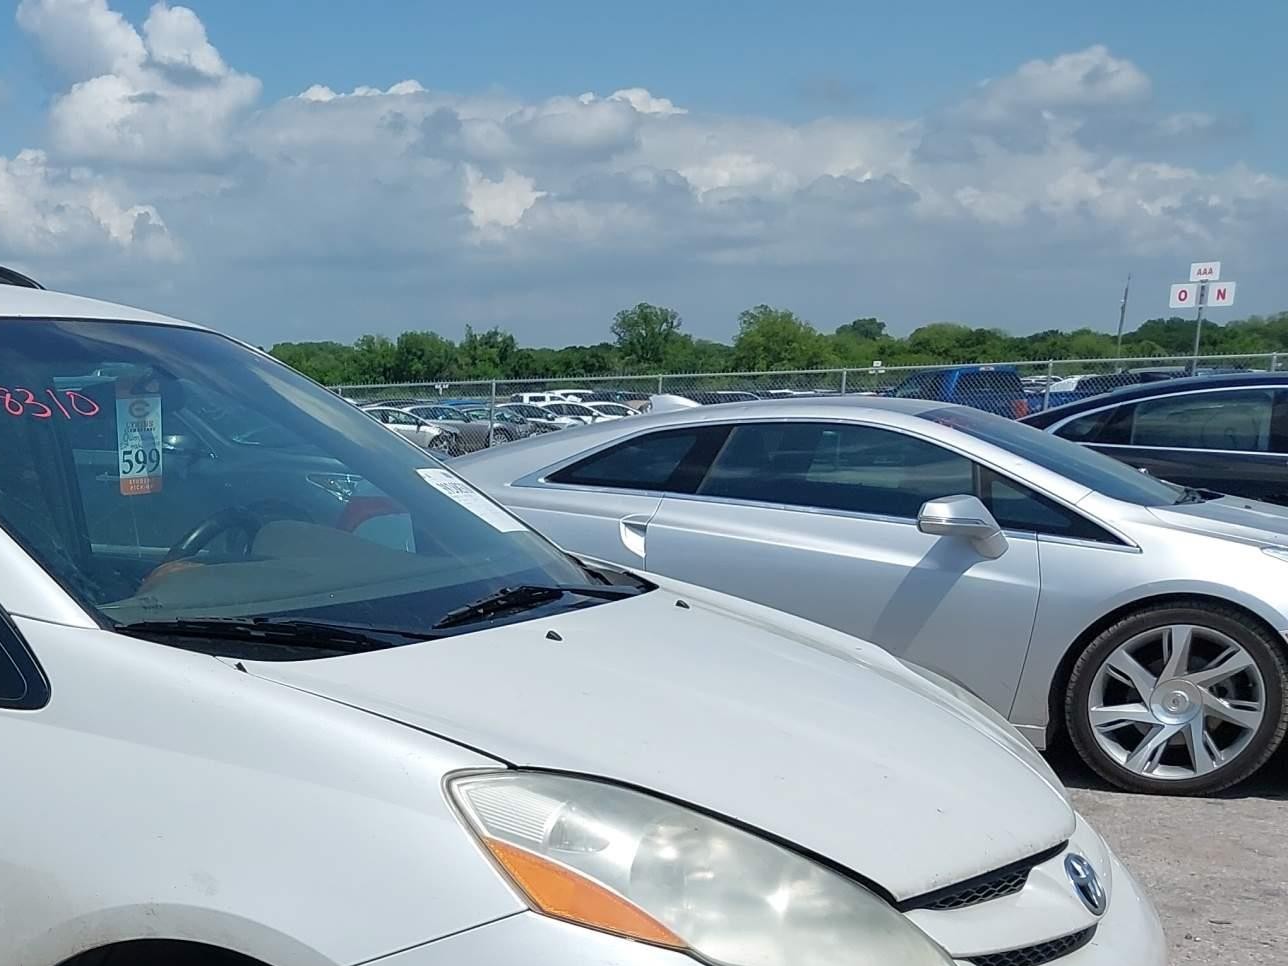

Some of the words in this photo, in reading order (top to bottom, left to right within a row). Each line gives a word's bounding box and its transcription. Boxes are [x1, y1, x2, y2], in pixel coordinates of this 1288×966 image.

[1196, 267, 1214, 276] AAA
[1178, 289, 1188, 302] O
[1216, 288, 1227, 301] N
[122, 449, 160, 474] 599
